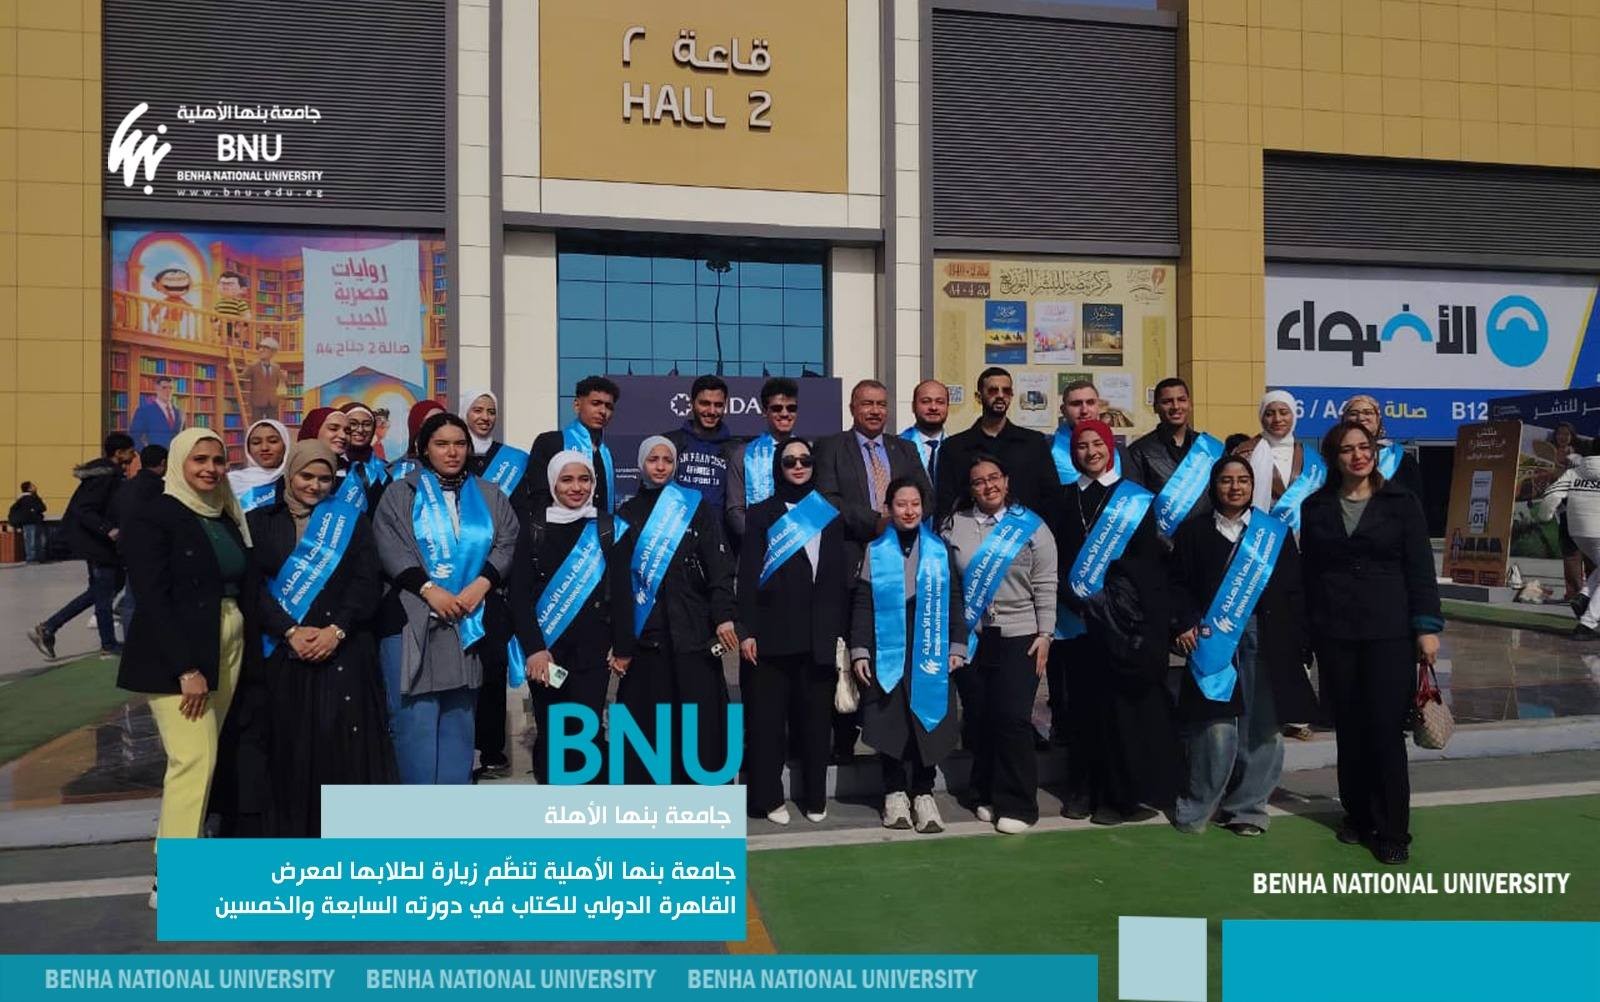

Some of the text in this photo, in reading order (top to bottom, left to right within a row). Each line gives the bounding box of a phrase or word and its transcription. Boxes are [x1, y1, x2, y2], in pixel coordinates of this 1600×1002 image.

[672, 29, 771, 74] قاعة
[622, 82, 772, 131] HALL 2
[331, 257, 388, 283] روايات
[334, 282, 388, 306] مصرية
[336, 306, 388, 330] للجيب
[1277, 300, 1478, 367] الأضواء
[1384, 400, 1427, 418] صالة
[1451, 401, 1489, 420] B12
